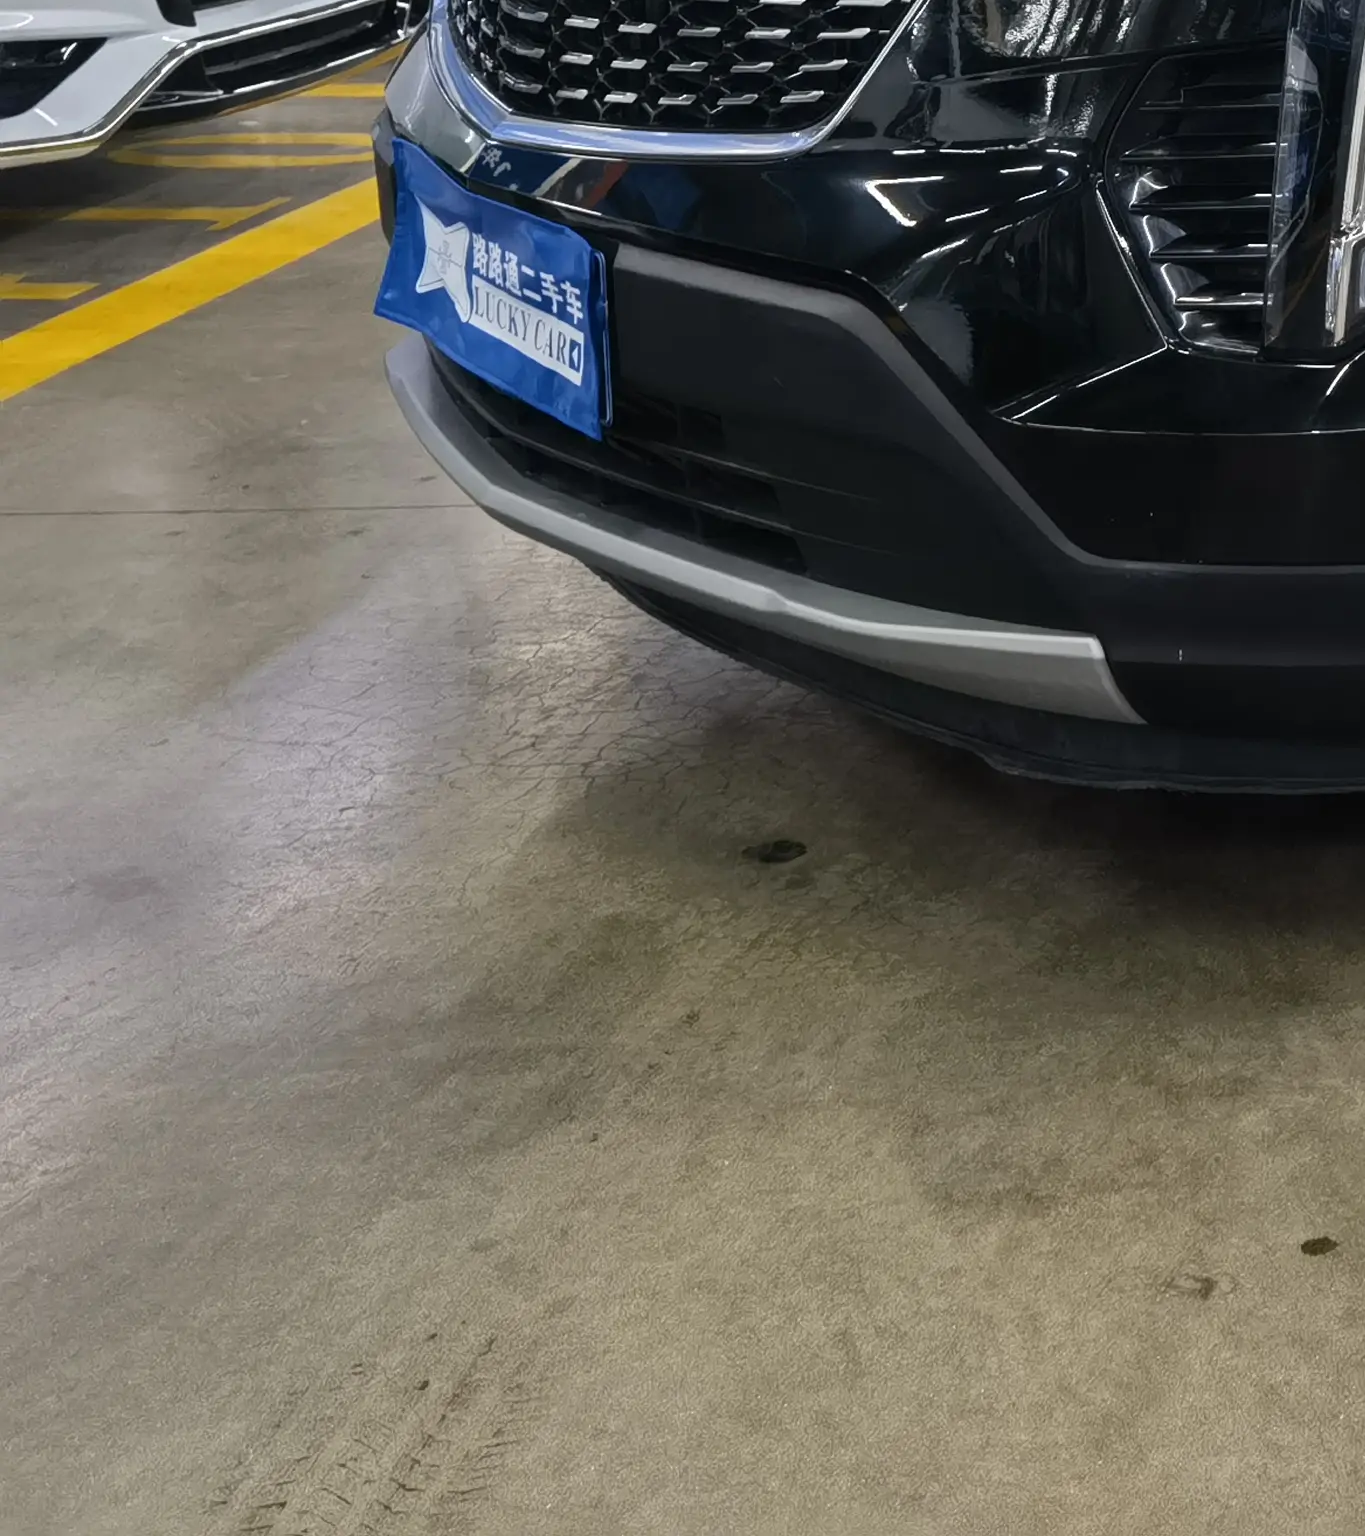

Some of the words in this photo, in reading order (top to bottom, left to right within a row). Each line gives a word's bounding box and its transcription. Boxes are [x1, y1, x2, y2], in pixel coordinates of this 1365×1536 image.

[471, 232, 585, 325] 路路通二手车
[473, 285, 532, 343] LUCKY
[533, 317, 569, 366] CAR
